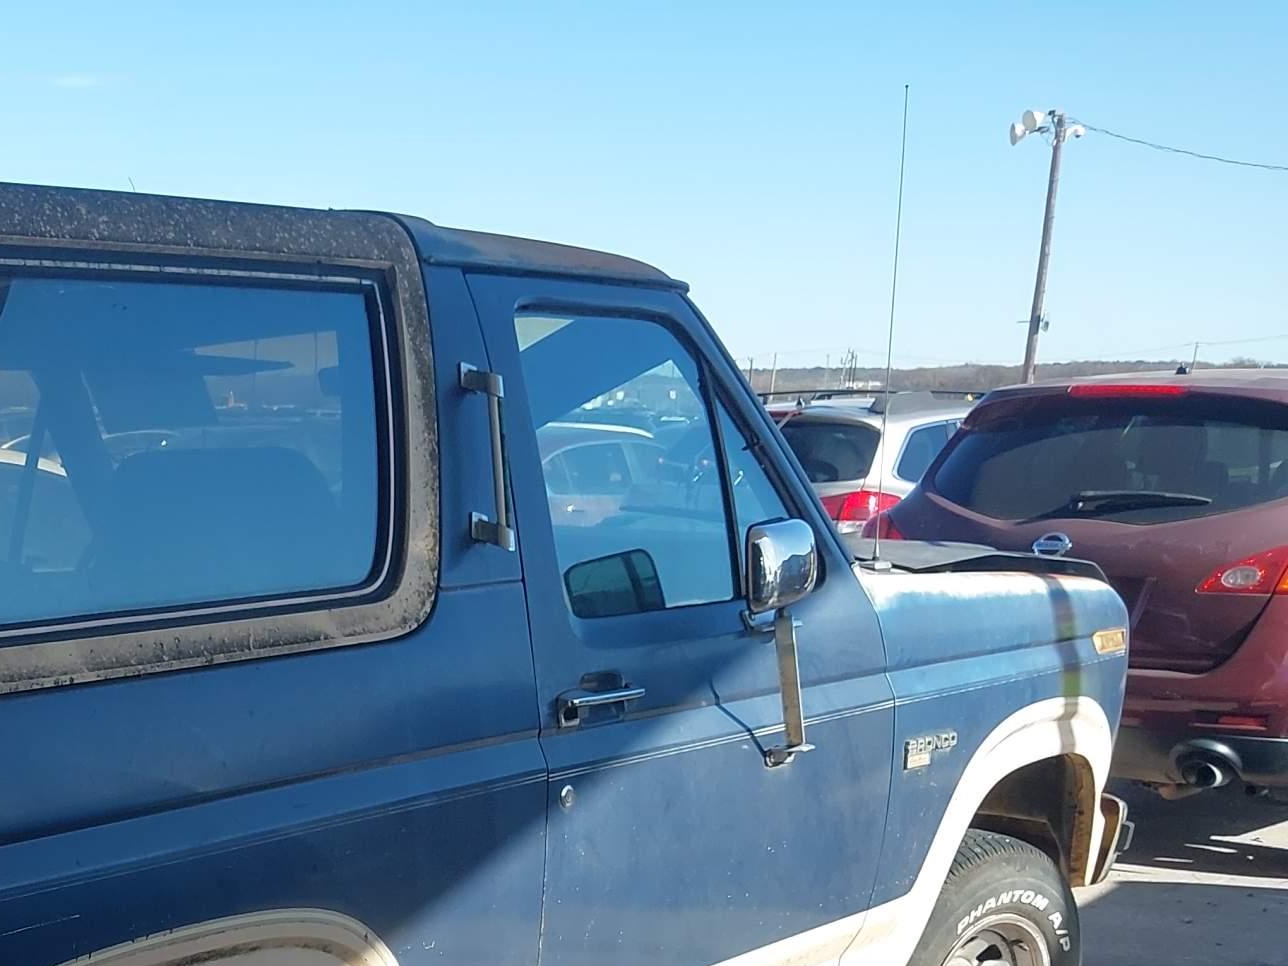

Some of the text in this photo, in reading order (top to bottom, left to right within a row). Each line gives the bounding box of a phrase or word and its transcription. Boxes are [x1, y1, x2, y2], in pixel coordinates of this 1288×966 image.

[906, 732, 958, 753] BRONCO
[956, 888, 1070, 953] PHANTOM A/P
